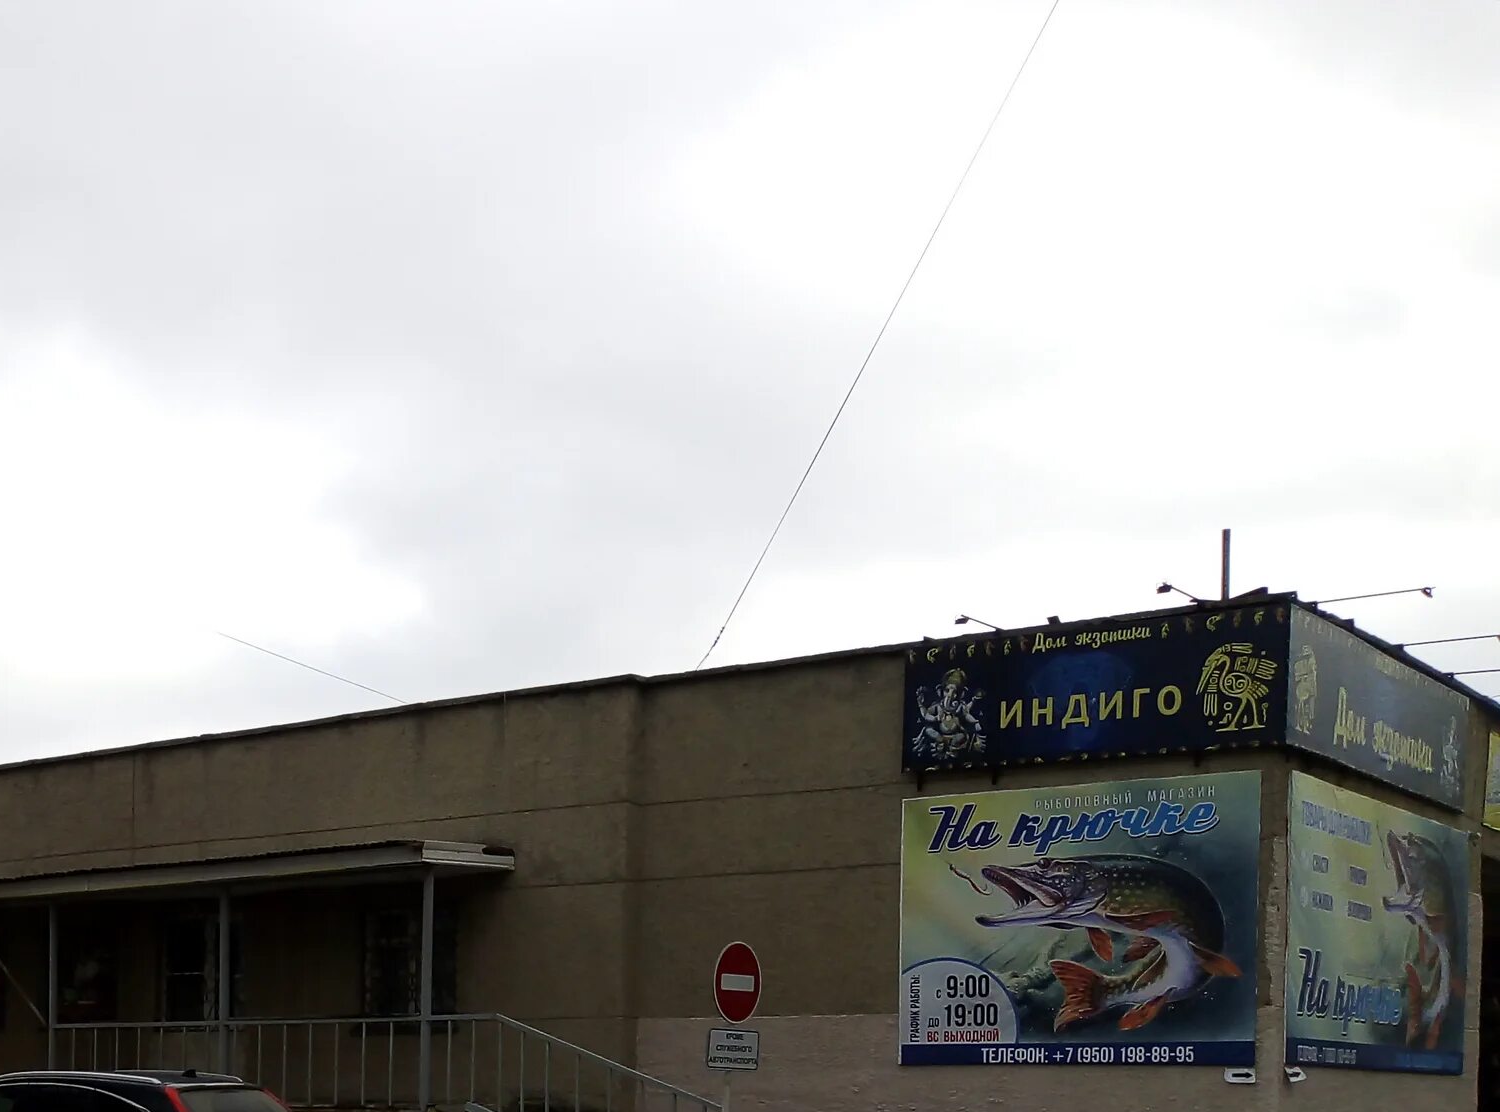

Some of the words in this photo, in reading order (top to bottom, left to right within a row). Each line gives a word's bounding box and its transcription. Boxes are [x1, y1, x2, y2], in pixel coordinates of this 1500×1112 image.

[1032, 633, 1067, 653] Дом
[1075, 626, 1151, 649] экзотики
[1000, 685, 1182, 730] ИНДИГО
[1034, 792, 1133, 809] РЫБОЛОВНЫЙ
[1147, 785, 1216, 801] МАГАЗИН
[928, 803, 1002, 853] На
[1007, 800, 1221, 856] крючке
[910, 974, 921, 1008] РАБОТЫ:
[946, 974, 990, 998] 9:00
[910, 1010, 920, 1042] ГРАФИК
[944, 1003, 999, 1027] 19:00
[927, 1031, 939, 1042] ВС
[943, 1028, 999, 1043] ВЫХОДНОЙ
[981, 1047, 1048, 1063] ТЕЛЕФОН:
[1053, 1047, 1073, 1062] +7
[1077, 1046, 1114, 1063] (950)
[1120, 1046, 1194, 1063] 198-89-95
